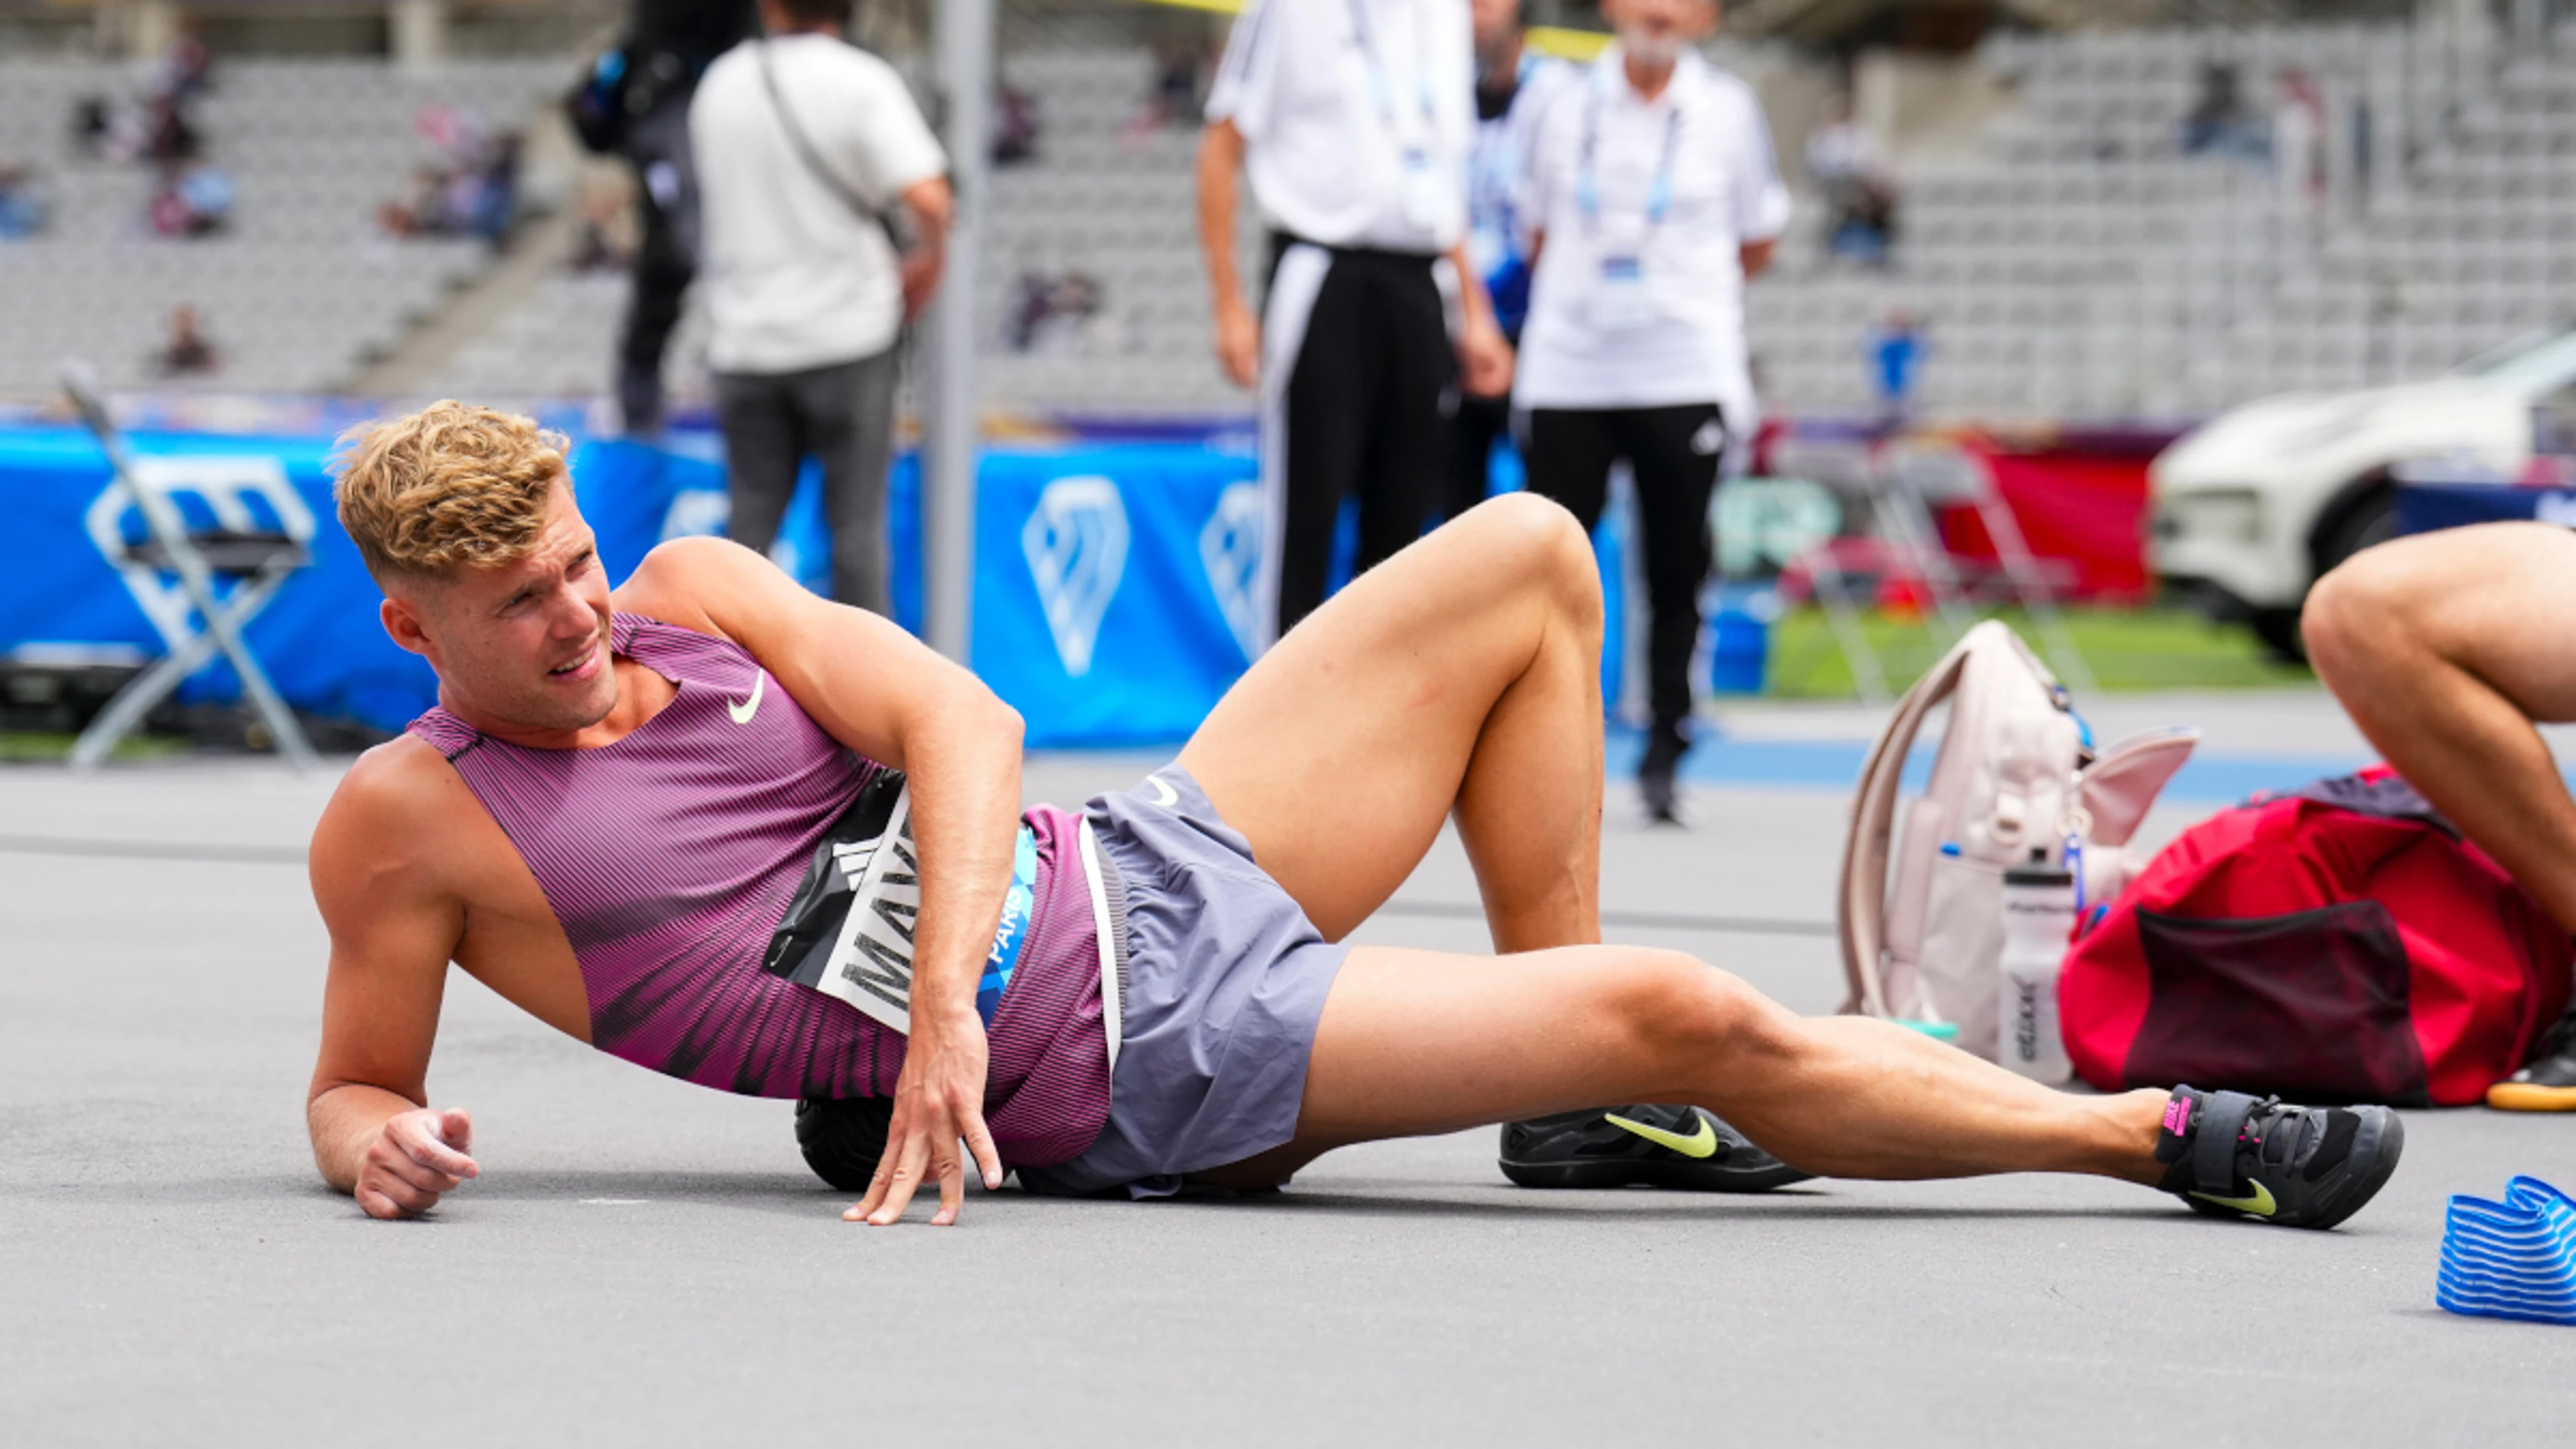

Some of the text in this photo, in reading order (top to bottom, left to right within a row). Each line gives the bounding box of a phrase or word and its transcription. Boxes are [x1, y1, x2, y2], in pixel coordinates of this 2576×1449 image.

[841, 812, 919, 1013] MAY
[988, 890, 1021, 964] PARIS
[2163, 1099, 2180, 1132] NIKE
